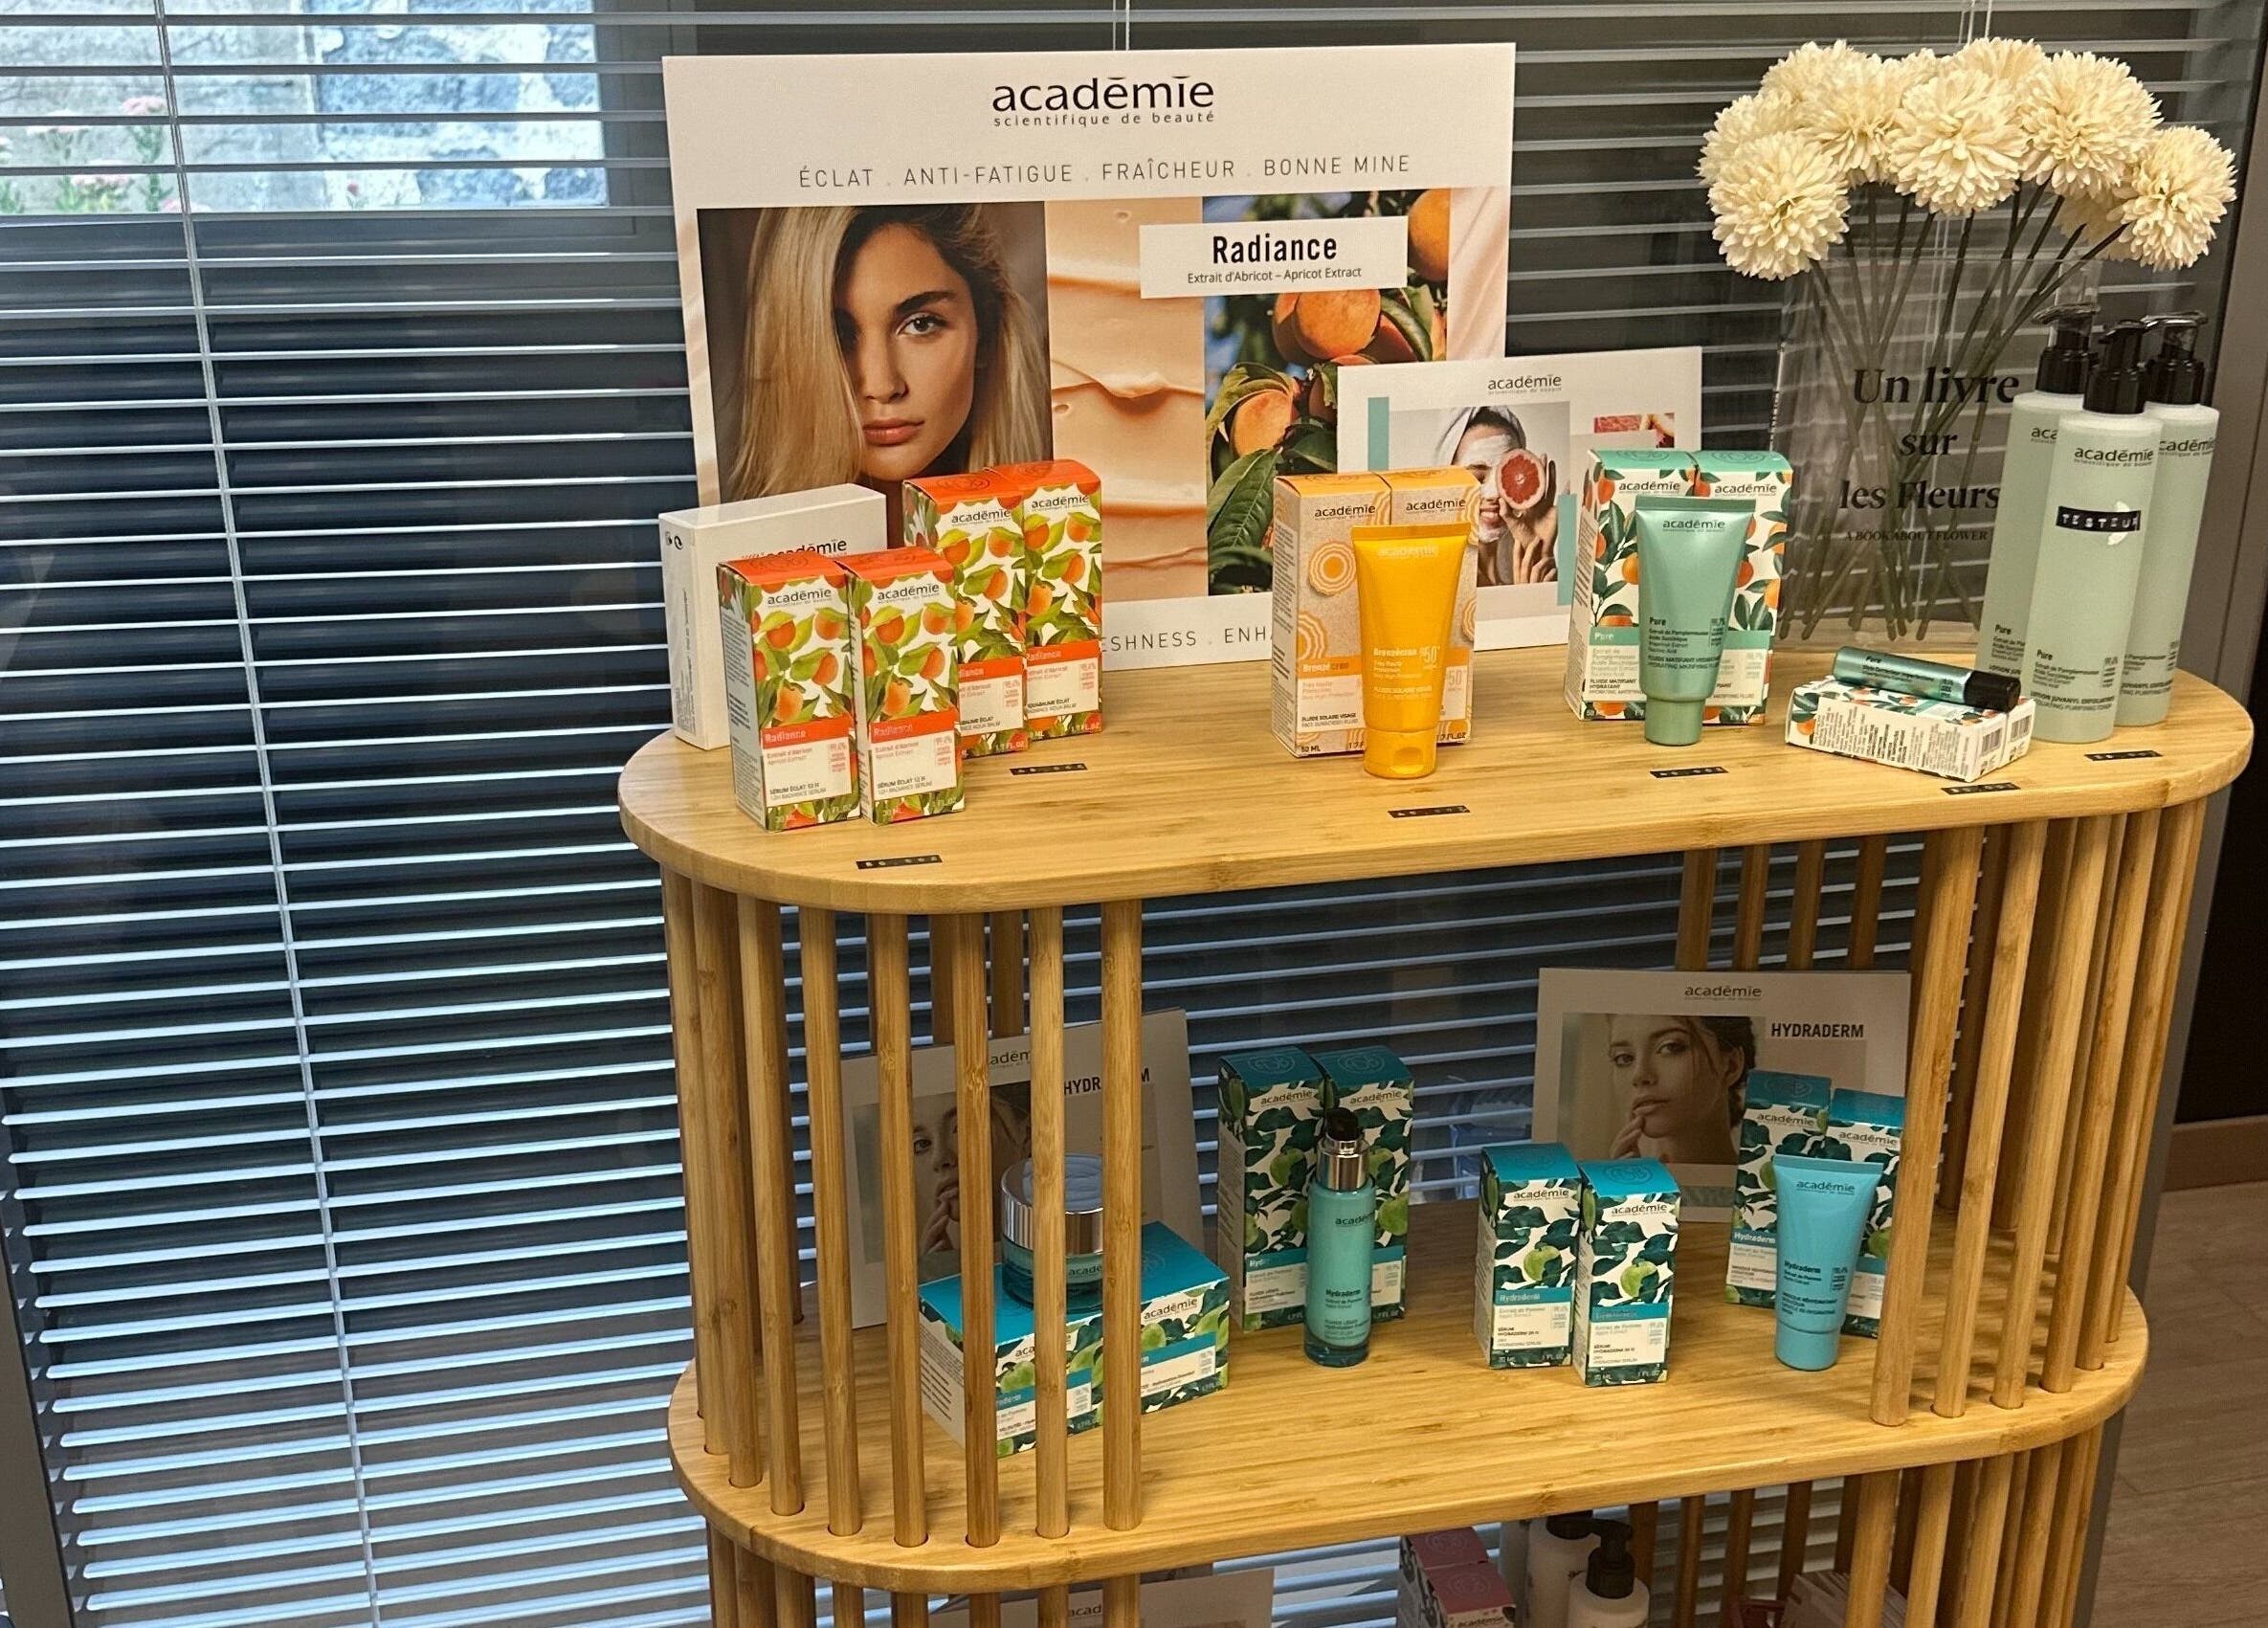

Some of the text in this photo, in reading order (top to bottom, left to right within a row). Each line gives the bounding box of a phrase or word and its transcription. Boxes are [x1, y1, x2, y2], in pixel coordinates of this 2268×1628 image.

[994, 110, 1214, 127] scientifique de beauté
[799, 154, 1410, 188] ÉCLAT ANTI-FATIGUE FRAÎCHEUR BONNE MINE
[1212, 233, 1338, 264] Radiance
[1188, 267, 1362, 284] Extrait d'Abricot Apricot Extract
[1854, 367, 2020, 404] Un livre
[1900, 432, 1959, 456] sur
[1837, 479, 2001, 509] les Fleurs
[1225, 626, 1272, 644] ENH
[1770, 1022, 1865, 1038] HYDRADERM
